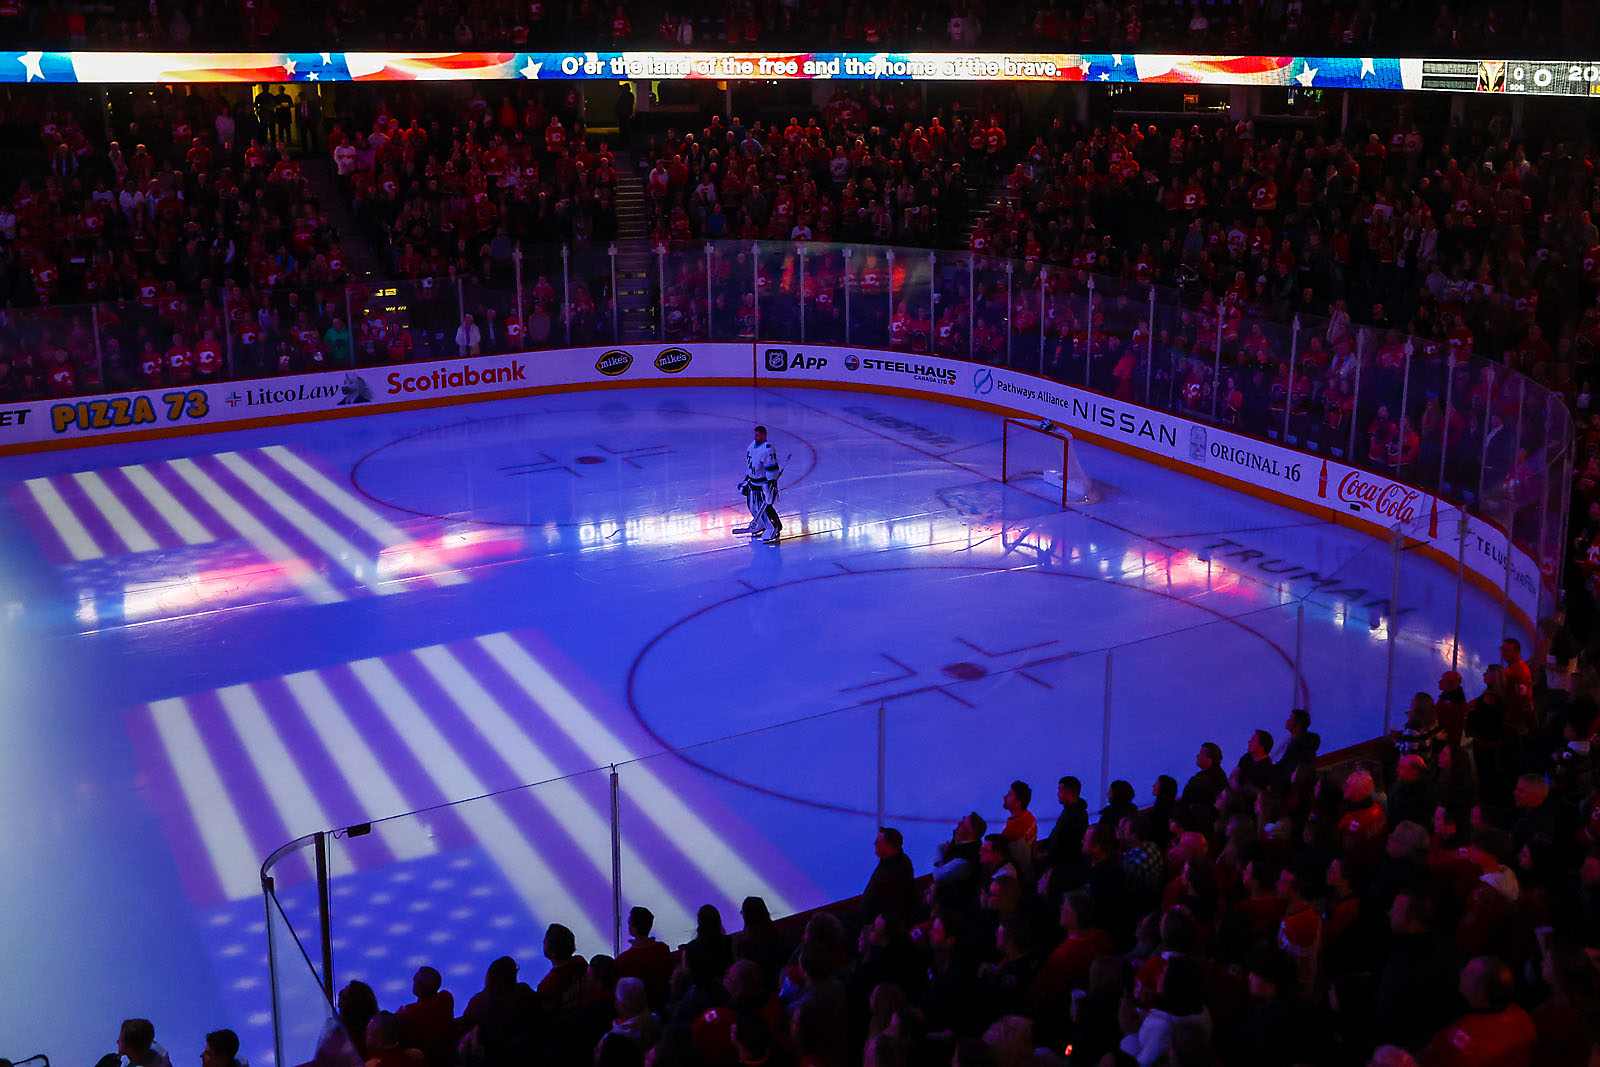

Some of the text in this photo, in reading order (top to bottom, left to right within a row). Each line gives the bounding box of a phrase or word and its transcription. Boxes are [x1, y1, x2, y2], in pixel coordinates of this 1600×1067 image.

[561, 57, 1062, 76] O'er the land of the free and the home of the brave.
[1513, 67, 1524, 81] 0
[1533, 69, 1552, 87] 0
[601, 355, 629, 369] mike's
[659, 353, 687, 367] mike's
[863, 358, 957, 380] STEELHAUS
[387, 360, 527, 394] Scotiabank
[913, 375, 948, 385] CANADA LTD
[997, 380, 1069, 408] Pathways Alliance
[50, 389, 210, 433] PIZZA 73
[1072, 398, 1177, 447] NISSAN
[1210, 442, 1301, 482] ORIGINAL 16
[1338, 471, 1419, 523] Coca-Cola
